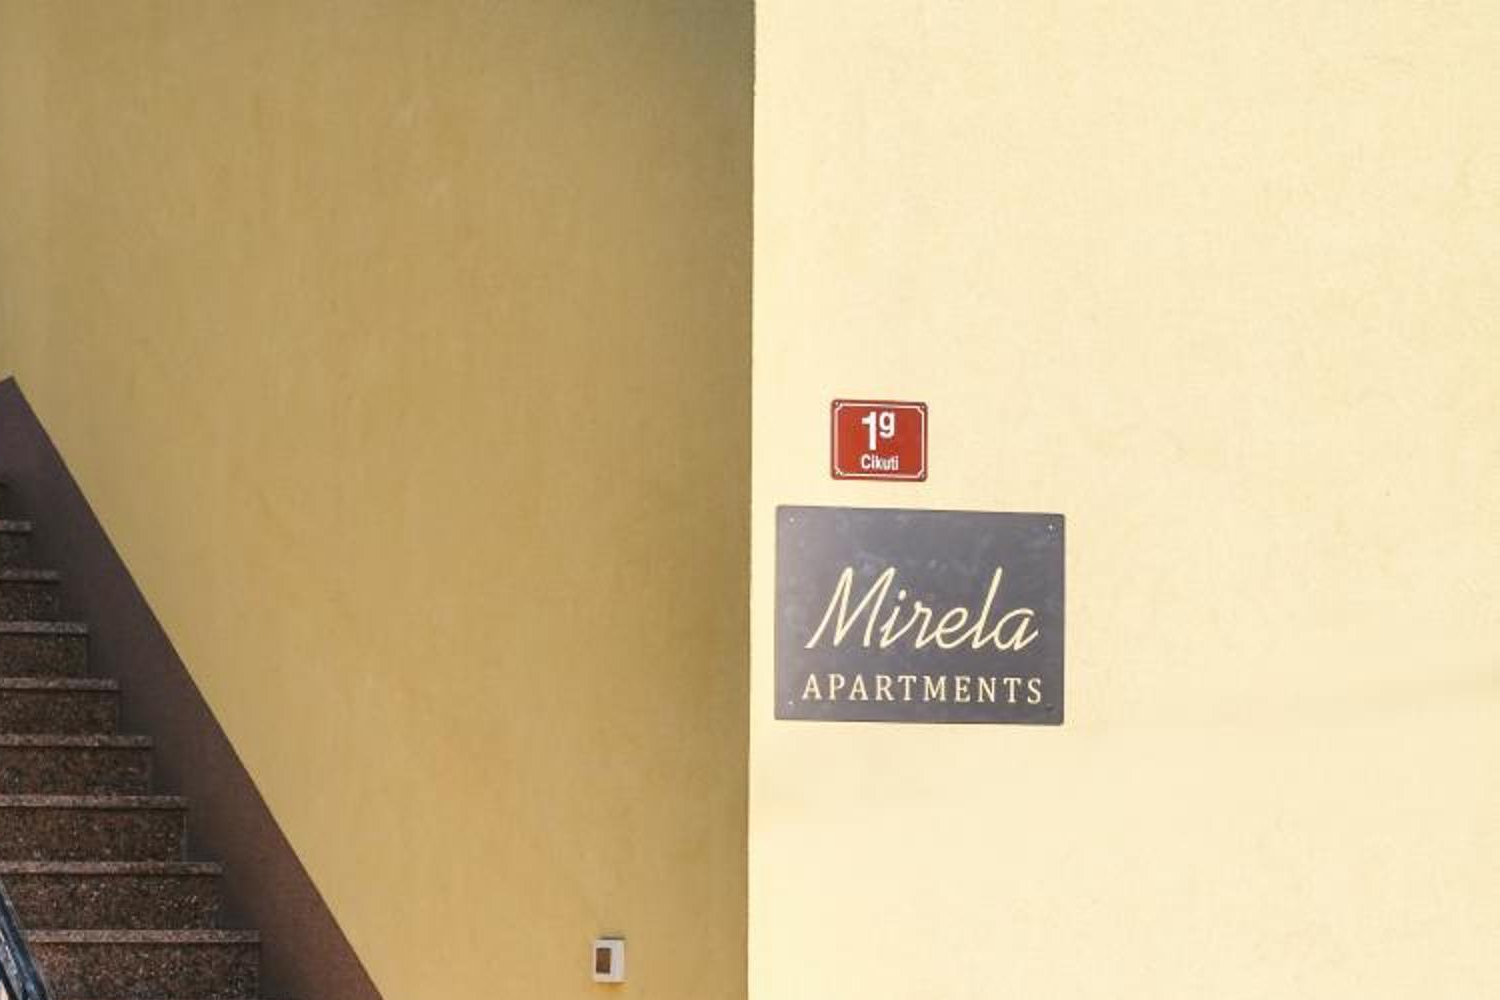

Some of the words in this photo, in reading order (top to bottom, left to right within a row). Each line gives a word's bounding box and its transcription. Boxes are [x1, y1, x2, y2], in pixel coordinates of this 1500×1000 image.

[861, 454, 899, 470] Cikuti
[804, 566, 1039, 651] Mirela
[801, 673, 1042, 704] APARTMENTS
